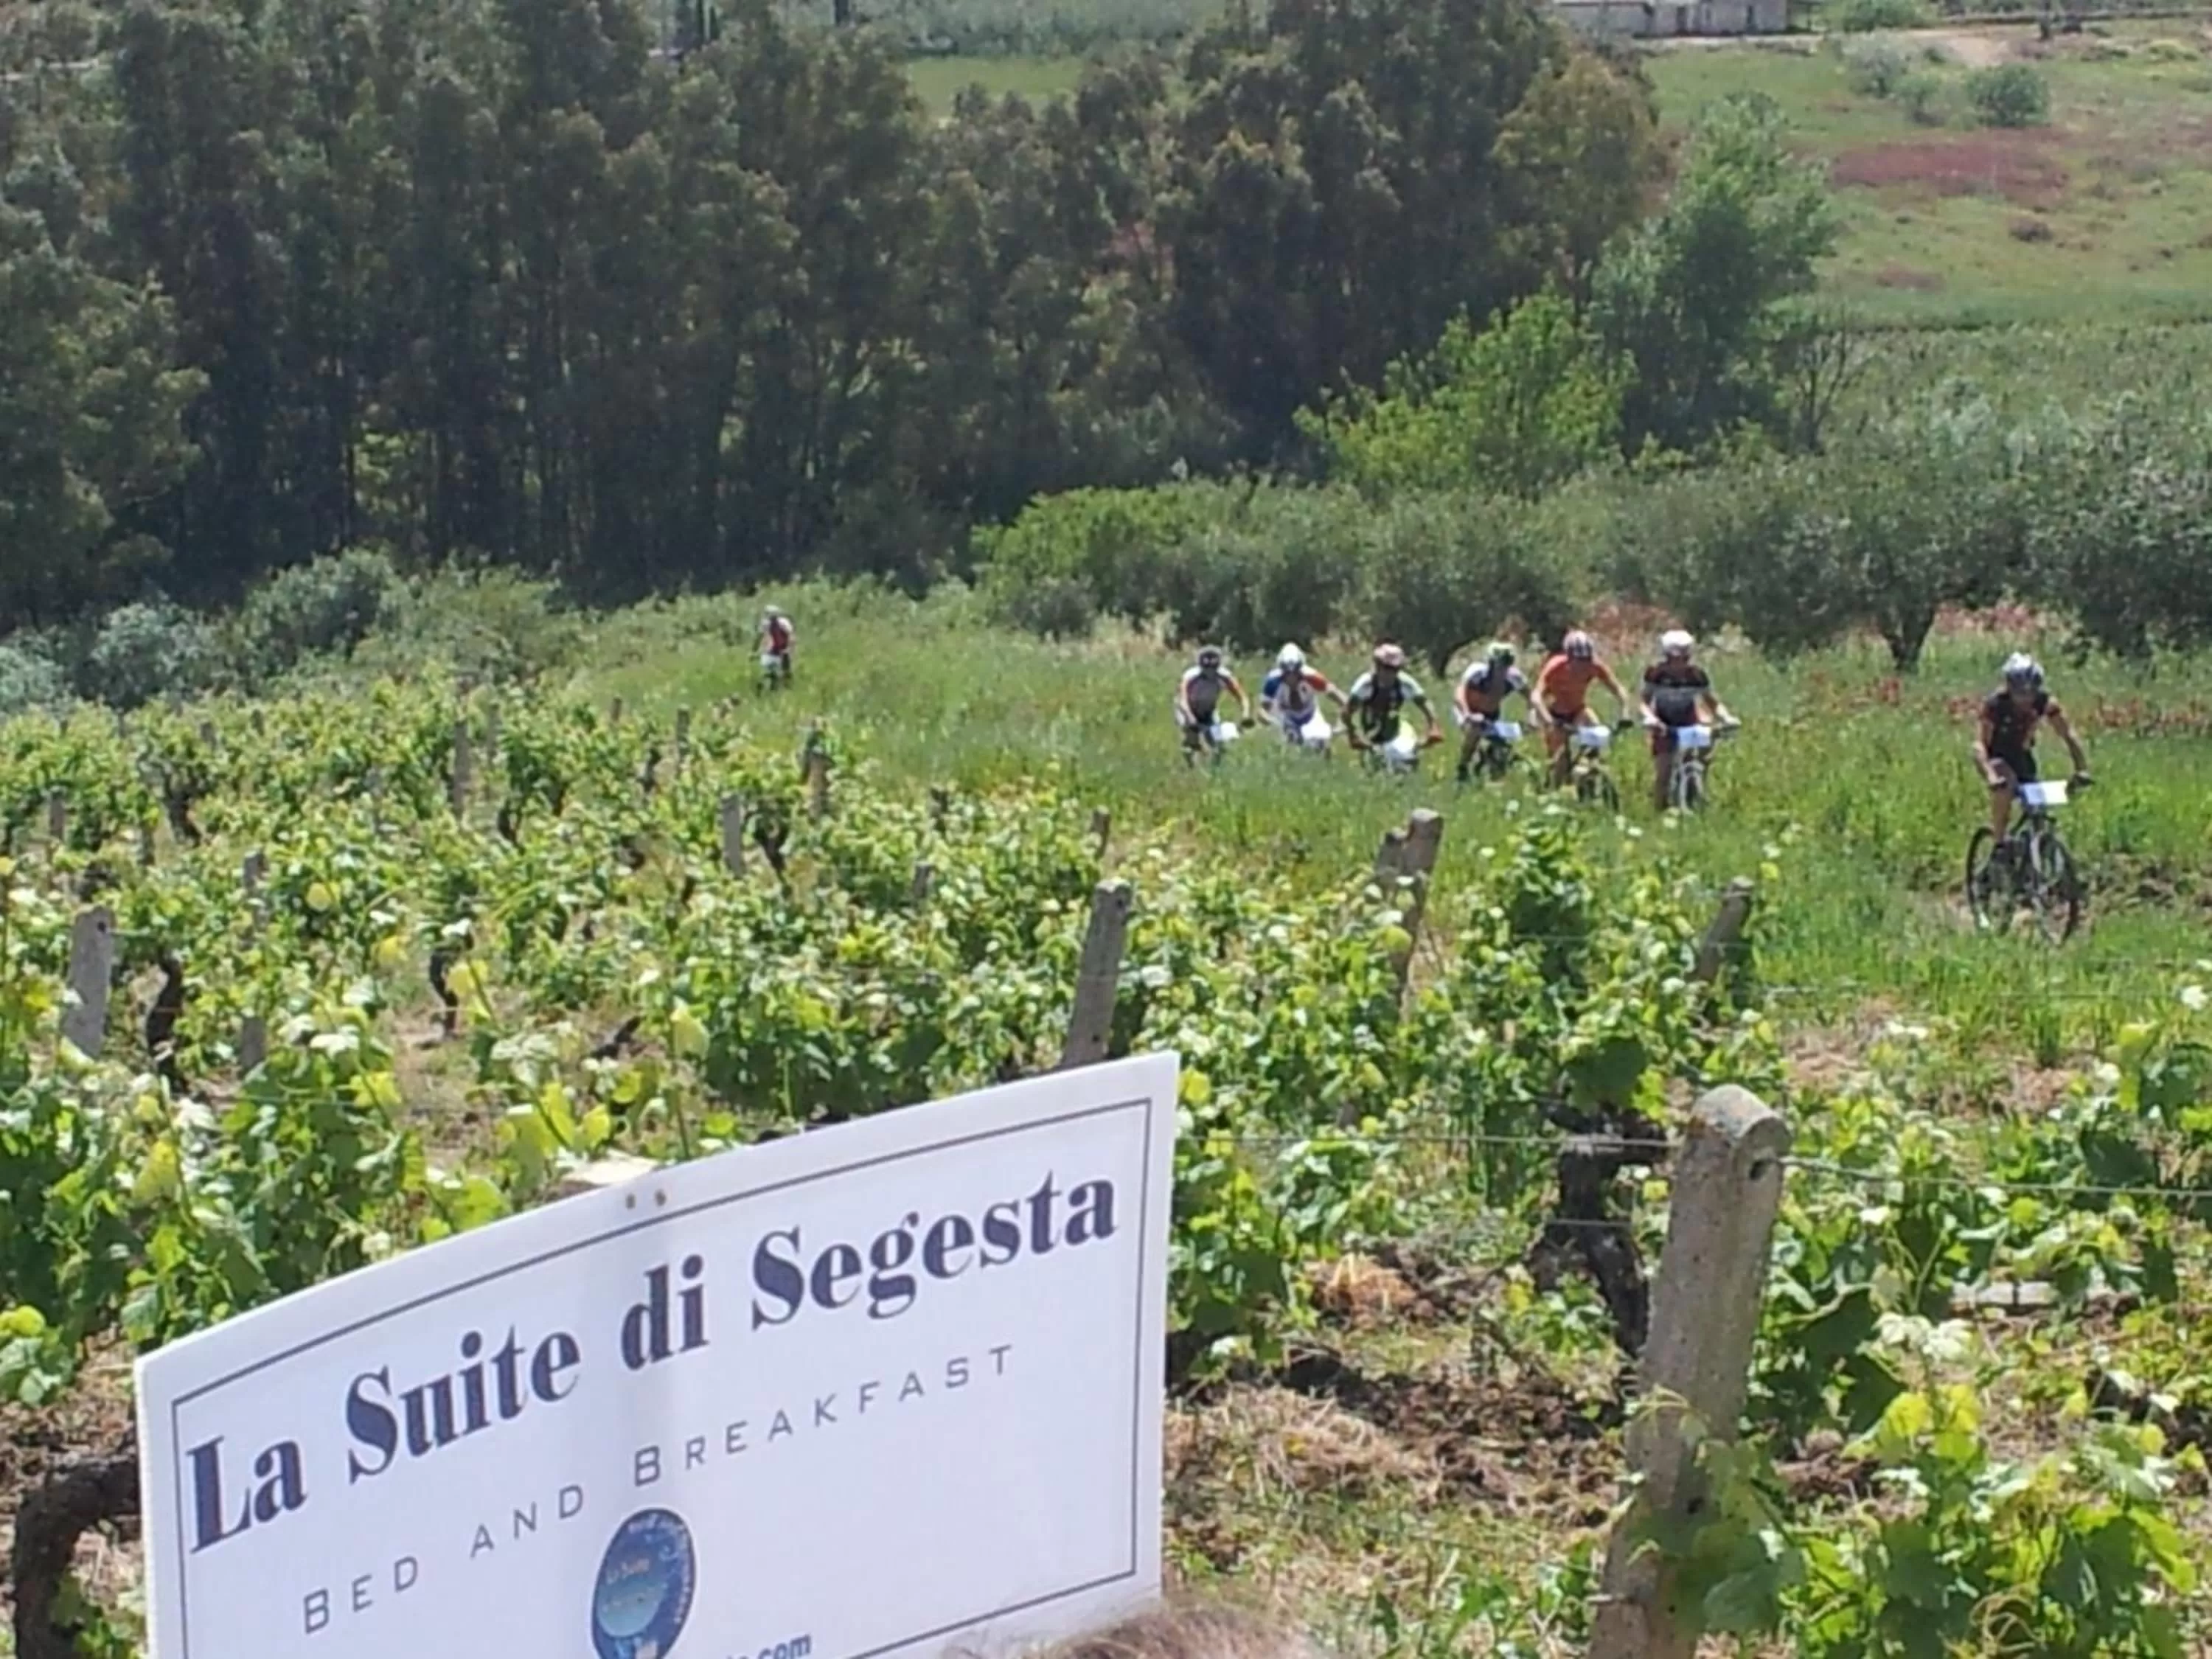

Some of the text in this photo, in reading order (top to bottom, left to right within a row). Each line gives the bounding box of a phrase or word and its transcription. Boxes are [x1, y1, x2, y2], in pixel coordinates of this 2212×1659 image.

[184, 1170, 1119, 1555] La Suite di Segesta
[303, 1344, 1013, 1635] BED AND BREAKFAST
